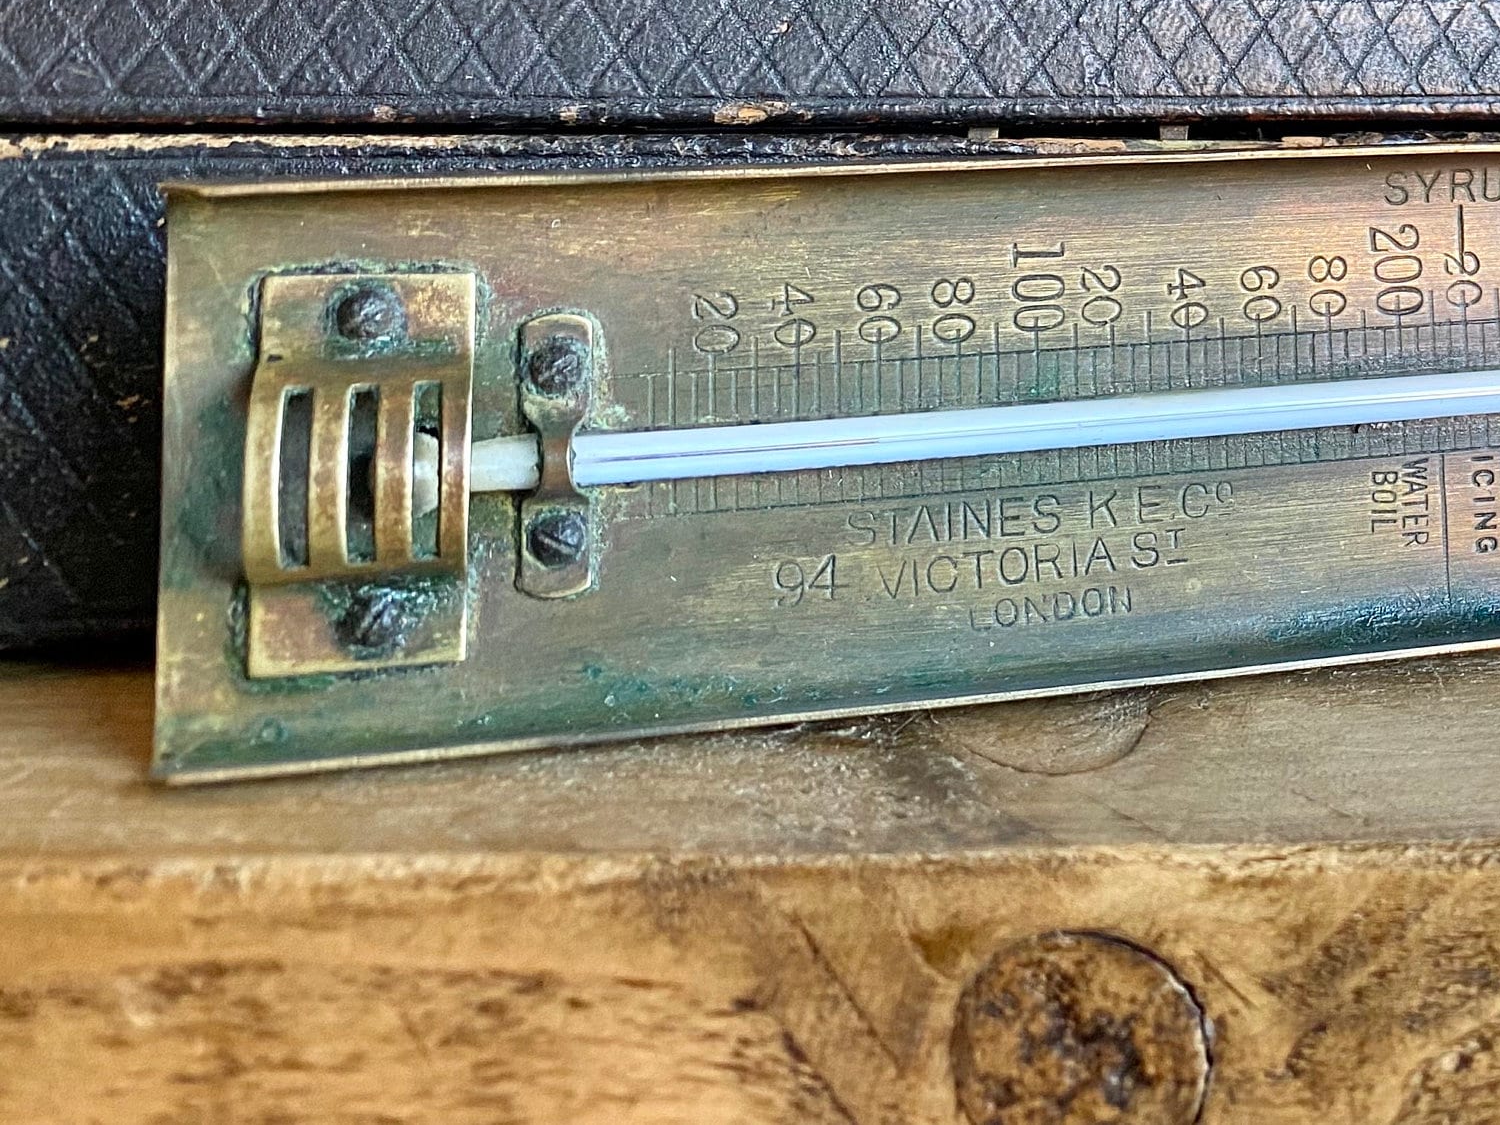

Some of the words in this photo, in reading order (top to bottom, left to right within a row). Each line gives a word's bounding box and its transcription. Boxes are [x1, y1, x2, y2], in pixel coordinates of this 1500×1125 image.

[1009, 241, 1066, 333] 100
[1080, 264, 1123, 327] 20
[1166, 267, 1209, 329] 40
[1240, 264, 1282, 323] 60
[1307, 254, 1348, 317] 80
[1368, 222, 1425, 316] 200
[1443, 249, 1484, 308] 20
[691, 291, 741, 355] 20
[768, 282, 817, 347] 40
[856, 282, 901, 344] 60
[931, 277, 977, 344] 80
[845, 492, 1062, 547] STAINES
[1370, 470, 1400, 535] BOIL
[1401, 457, 1431, 548] WATER
[1470, 454, 1498, 555] ICING
[773, 553, 850, 608] 94
[876, 535, 1118, 601] VICTORIA
[968, 585, 1133, 632] LONDON
